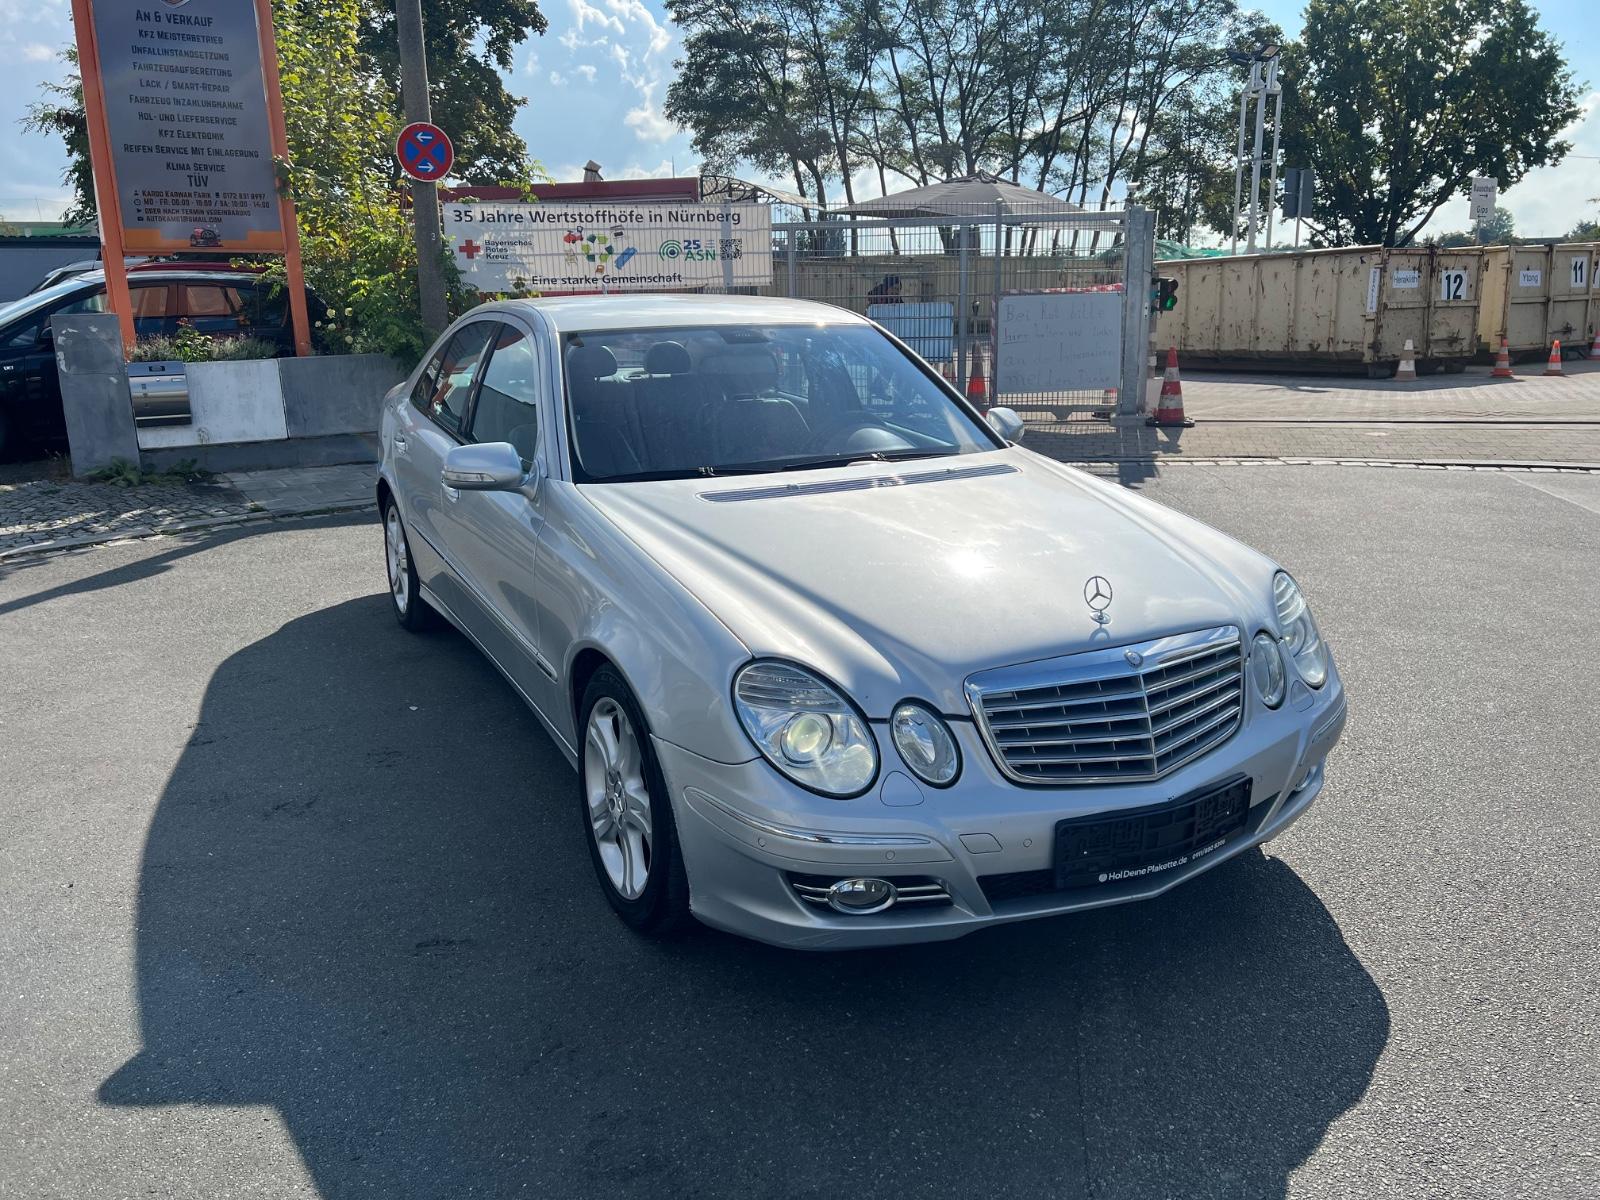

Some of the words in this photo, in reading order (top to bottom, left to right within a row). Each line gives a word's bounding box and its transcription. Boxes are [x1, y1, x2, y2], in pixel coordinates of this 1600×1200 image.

[154, 11, 162, 23] &
[165, 13, 214, 27] VERKAUF
[157, 30, 224, 44] MEISTERBETRIEB
[131, 45, 230, 62] UNFALLINSTANDSETZUNG
[132, 62, 233, 78] FAHRZEUGAUFBEREITUNG
[140, 78, 162, 89] LACK
[172, 81, 230, 93] SMART-REPAIR
[129, 94, 171, 106] FAHRZEUG
[177, 114, 238, 126] LIEFERSERVICE
[176, 130, 225, 141] ELEKTRONIK
[124, 143, 154, 154] REIFEN
[156, 144, 189, 156] SERVICE
[191, 146, 205, 156] MIT
[207, 148, 260, 158] EINLAGERUNG
[166, 162, 191, 172] KLIMA
[193, 163, 226, 172] SERVICE
[186, 172, 210, 188] TÜV
[1476, 205, 1489, 214] Gips
[453, 209, 474, 223] 35
[480, 209, 524, 224] Jahre
[528, 208, 644, 224] Wertstoffhöfe
[648, 210, 664, 224] in
[668, 210, 741, 226] Nürnberg
[684, 240, 702, 250] 25
[684, 250, 716, 261] ASN
[1522, 273, 1539, 283] Ytong
[1572, 260, 1584, 283] 11
[532, 276, 558, 285] Eine
[561, 275, 598, 285] starke
[602, 273, 682, 284] Gemeinschaft
[1446, 274, 1464, 300] 12
[1003, 304, 1031, 322] Bei
